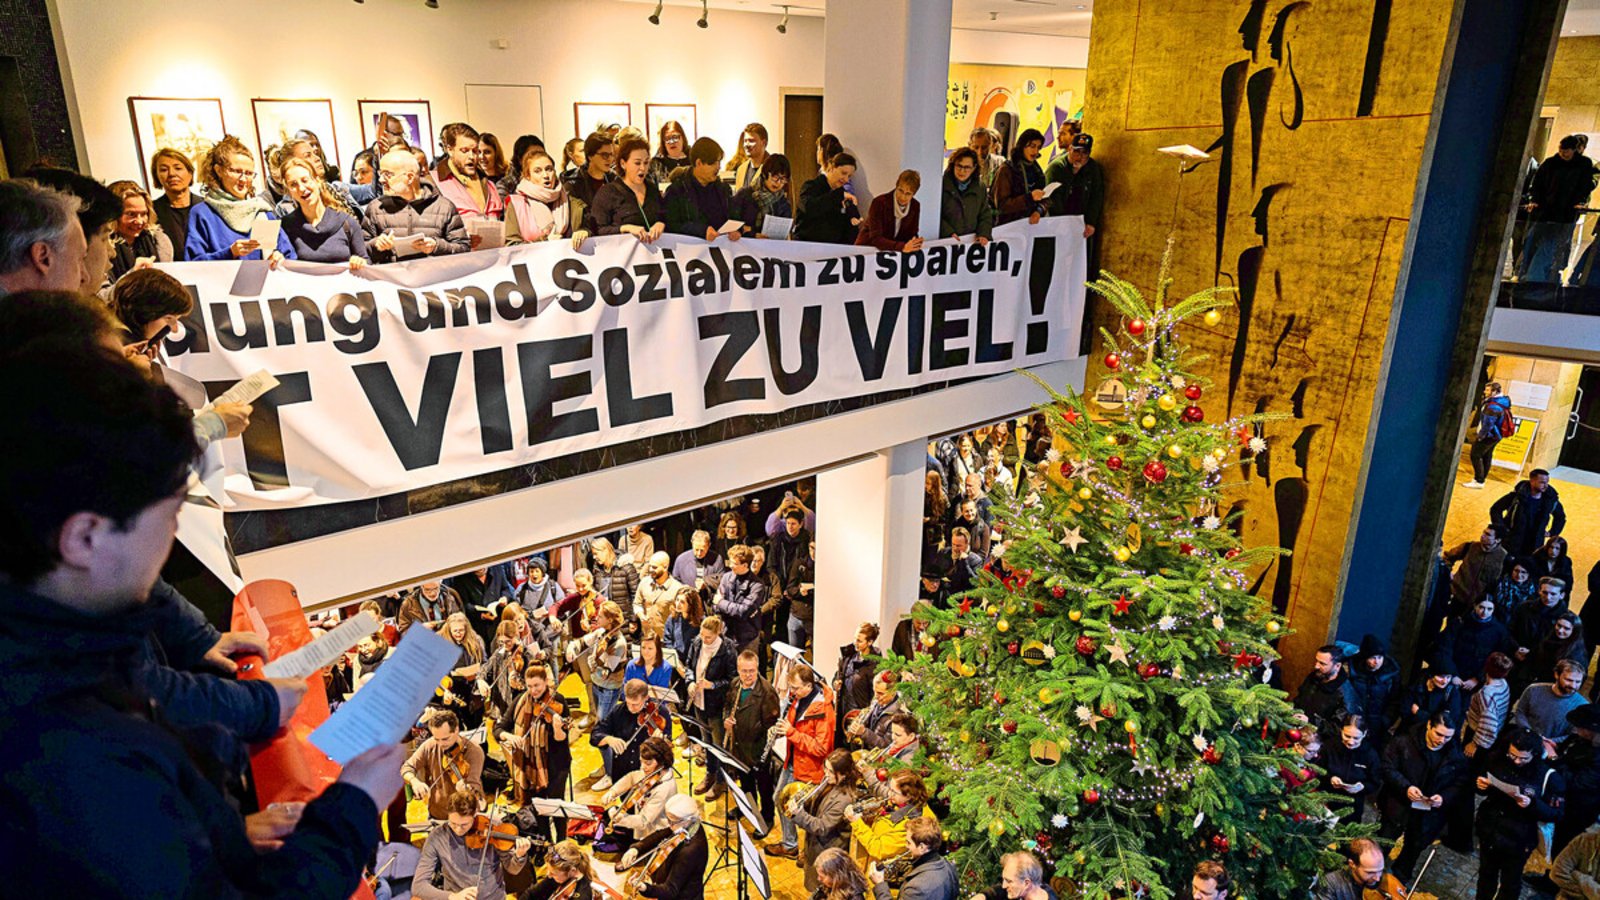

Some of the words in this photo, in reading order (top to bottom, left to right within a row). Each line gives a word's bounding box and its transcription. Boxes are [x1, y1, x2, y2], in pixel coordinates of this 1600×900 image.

[401, 264, 538, 331] und
[552, 248, 806, 313] Sozialem
[816, 255, 865, 286] zu
[875, 239, 1022, 289] sparen,
[352, 328, 673, 471] VIEL
[699, 305, 821, 409] ZU
